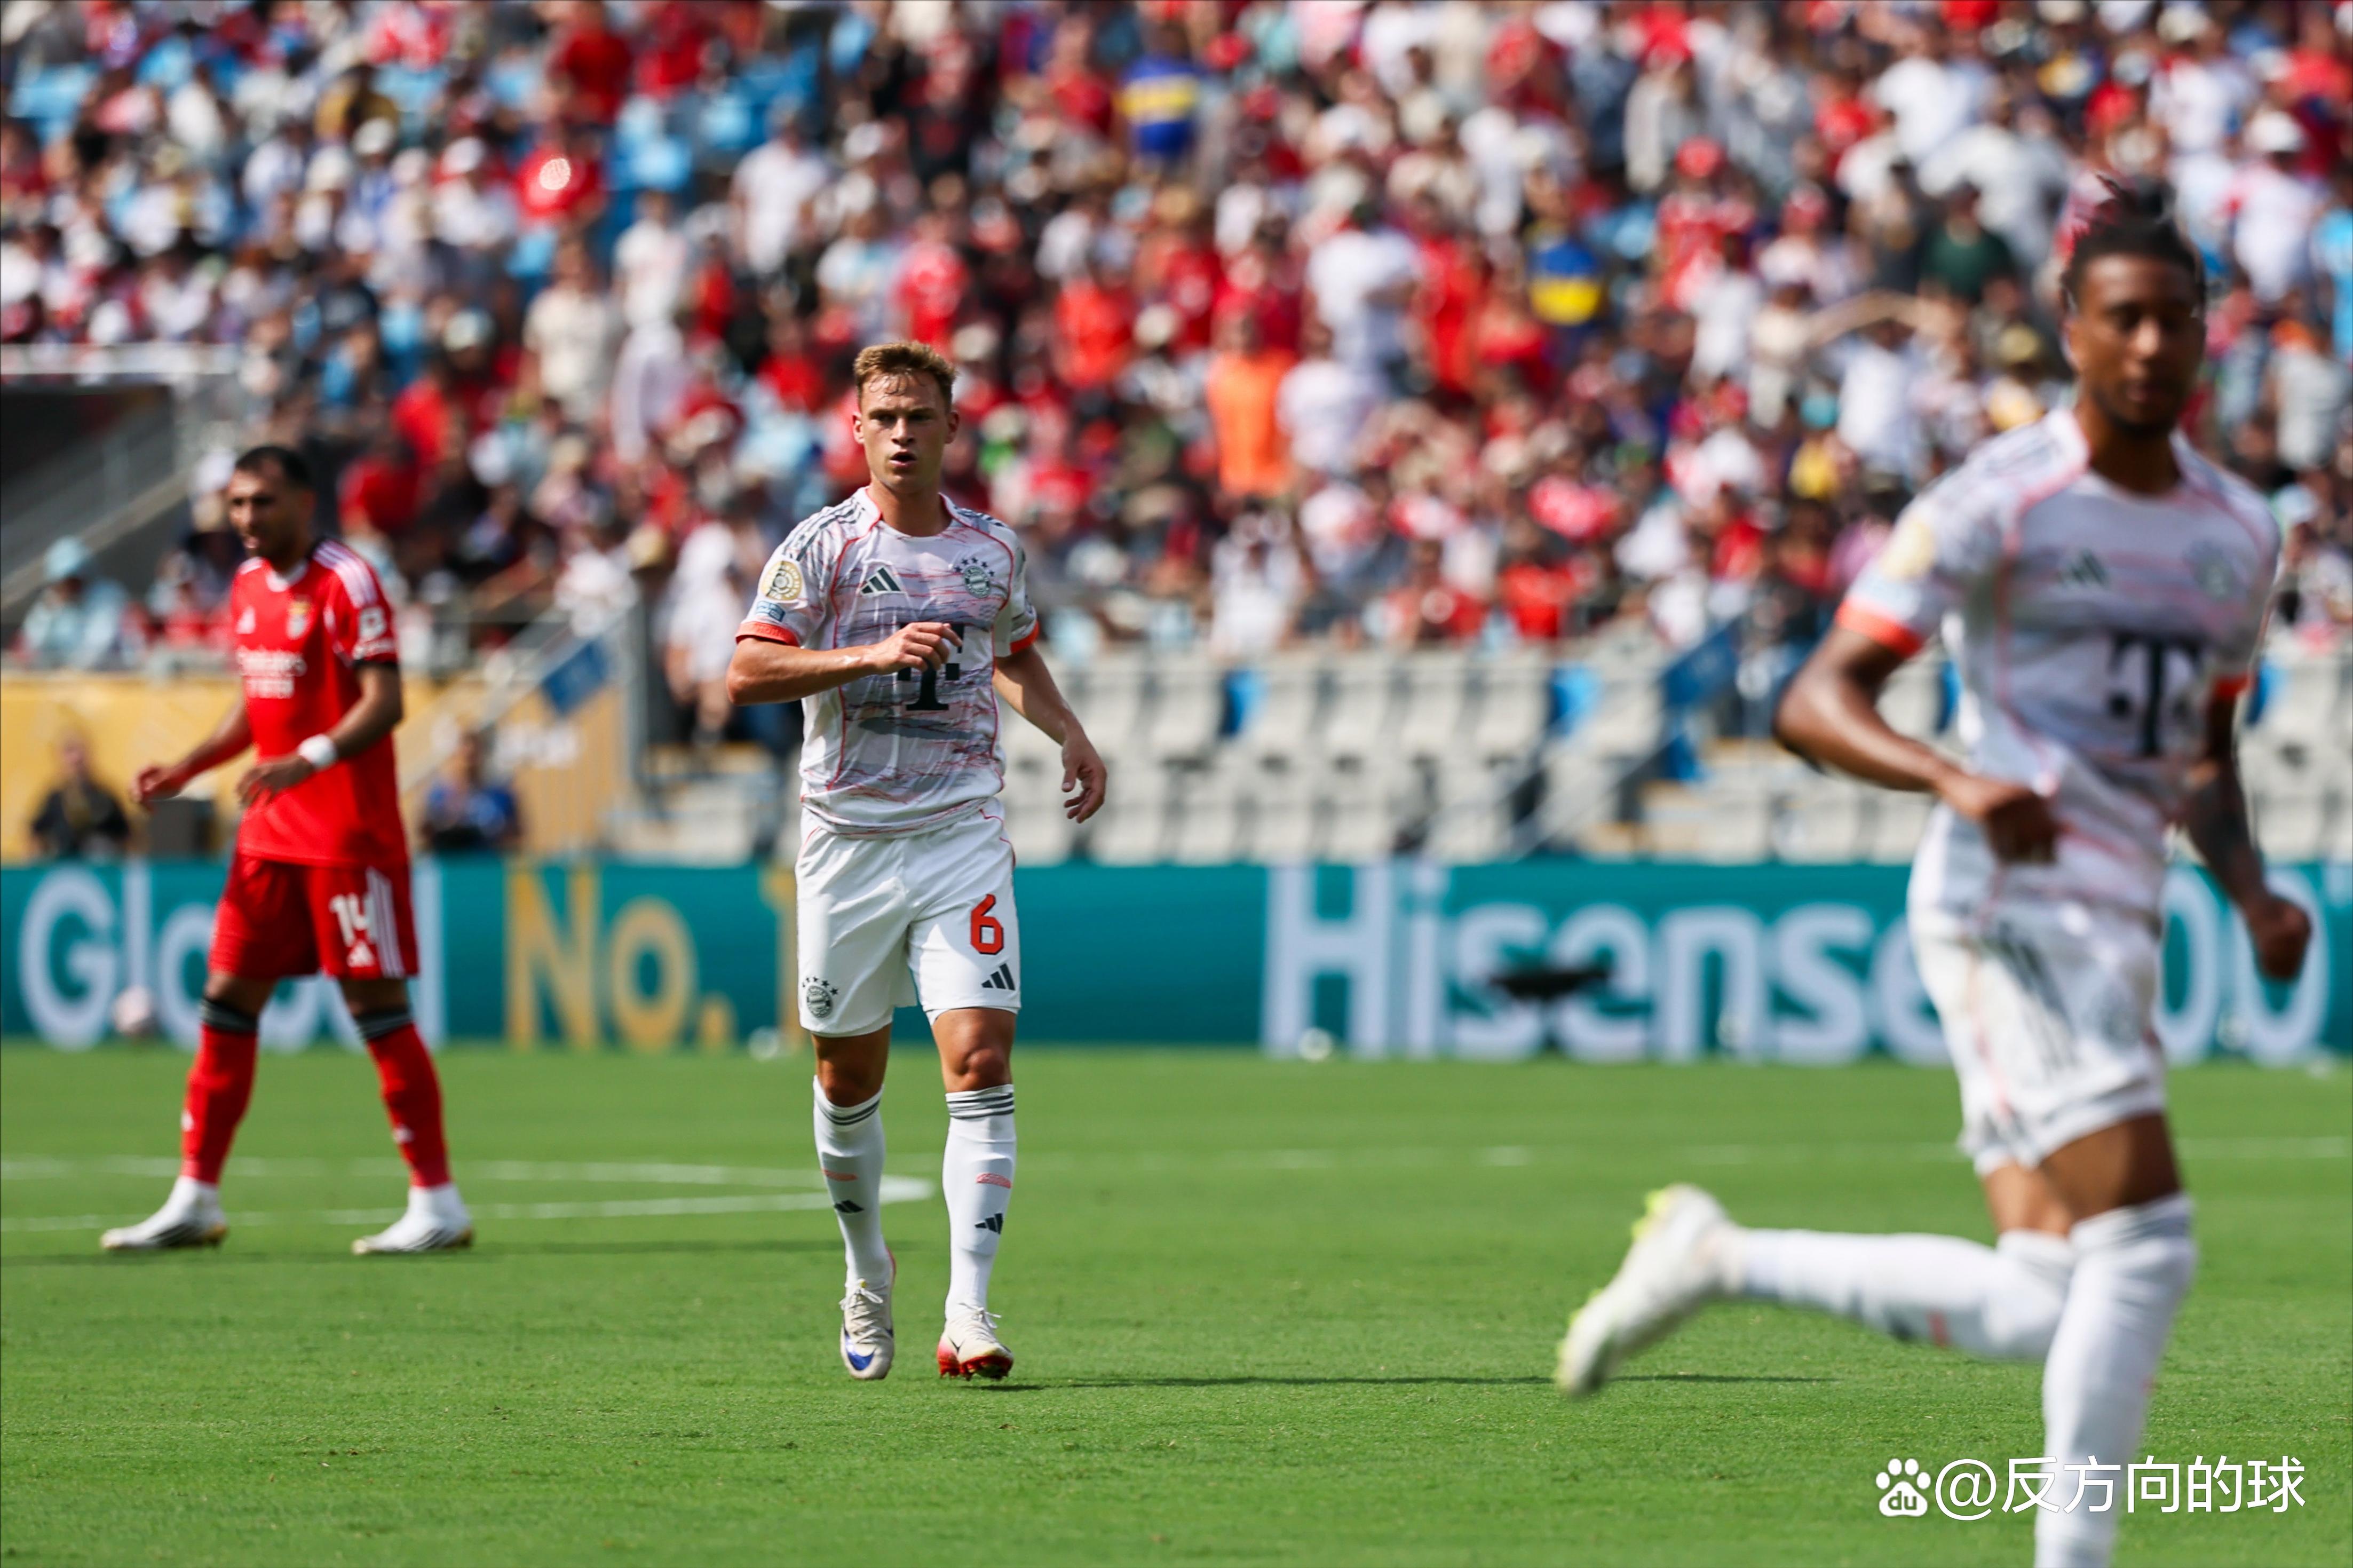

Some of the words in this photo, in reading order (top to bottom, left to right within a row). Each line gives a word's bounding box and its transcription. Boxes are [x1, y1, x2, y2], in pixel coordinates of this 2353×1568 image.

[2106, 629, 2203, 758] T
[329, 891, 377, 947] 14
[504, 859, 738, 1052] No.
[970, 893, 1004, 955] 6
